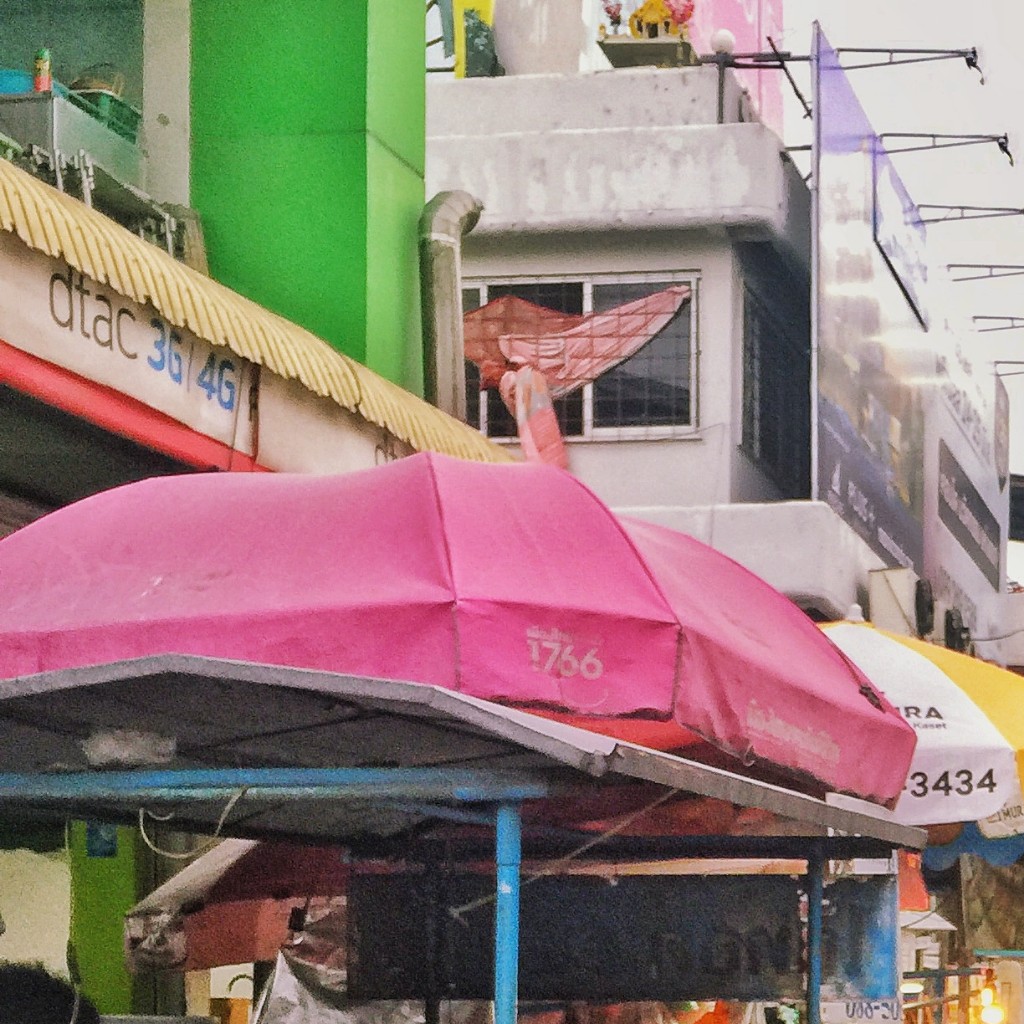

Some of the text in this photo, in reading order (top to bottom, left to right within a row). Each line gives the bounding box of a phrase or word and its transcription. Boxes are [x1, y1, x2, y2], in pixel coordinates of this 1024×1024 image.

[50, 267, 138, 360] dtac
[527, 638, 604, 680] 1766
[896, 705, 944, 721] RA
